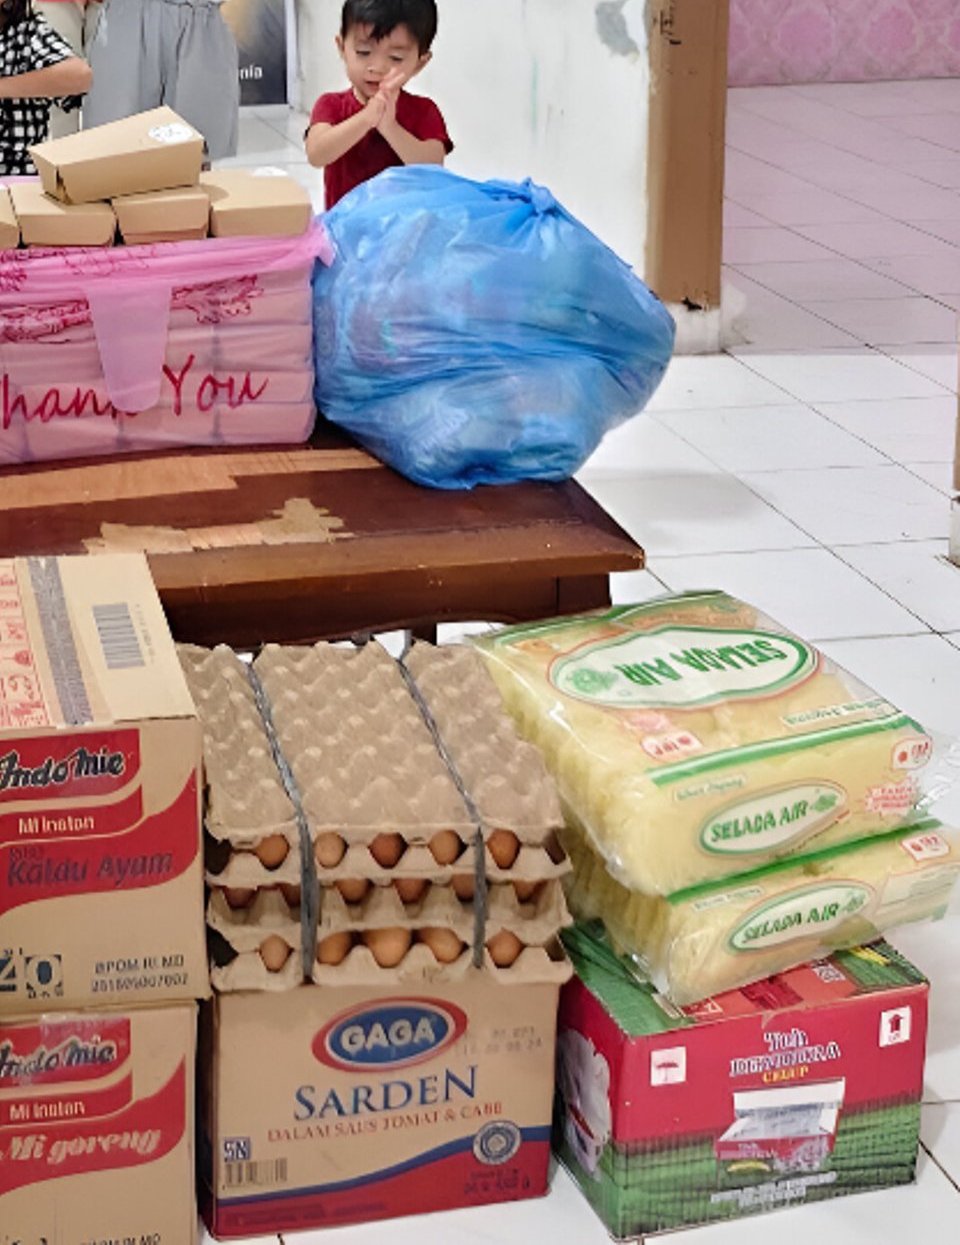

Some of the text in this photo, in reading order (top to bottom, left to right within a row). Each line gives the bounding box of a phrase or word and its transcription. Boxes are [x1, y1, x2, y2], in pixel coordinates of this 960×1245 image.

[162, 353, 269, 417] You
[613, 638, 788, 688] SELADA AIR
[710, 799, 810, 844] SELADA AIR
[7, 852, 173, 887] Kaldu Ayam
[742, 901, 840, 944] SELADA AIR
[341, 1015, 437, 1053] GAGA
[293, 1064, 480, 1122] SARDEN
[10, 1128, 162, 1165] Mi goreng
[267, 1125, 331, 1143] DALAM
[334, 1120, 378, 1137] SAUS
[382, 1114, 439, 1132] TOMAT
